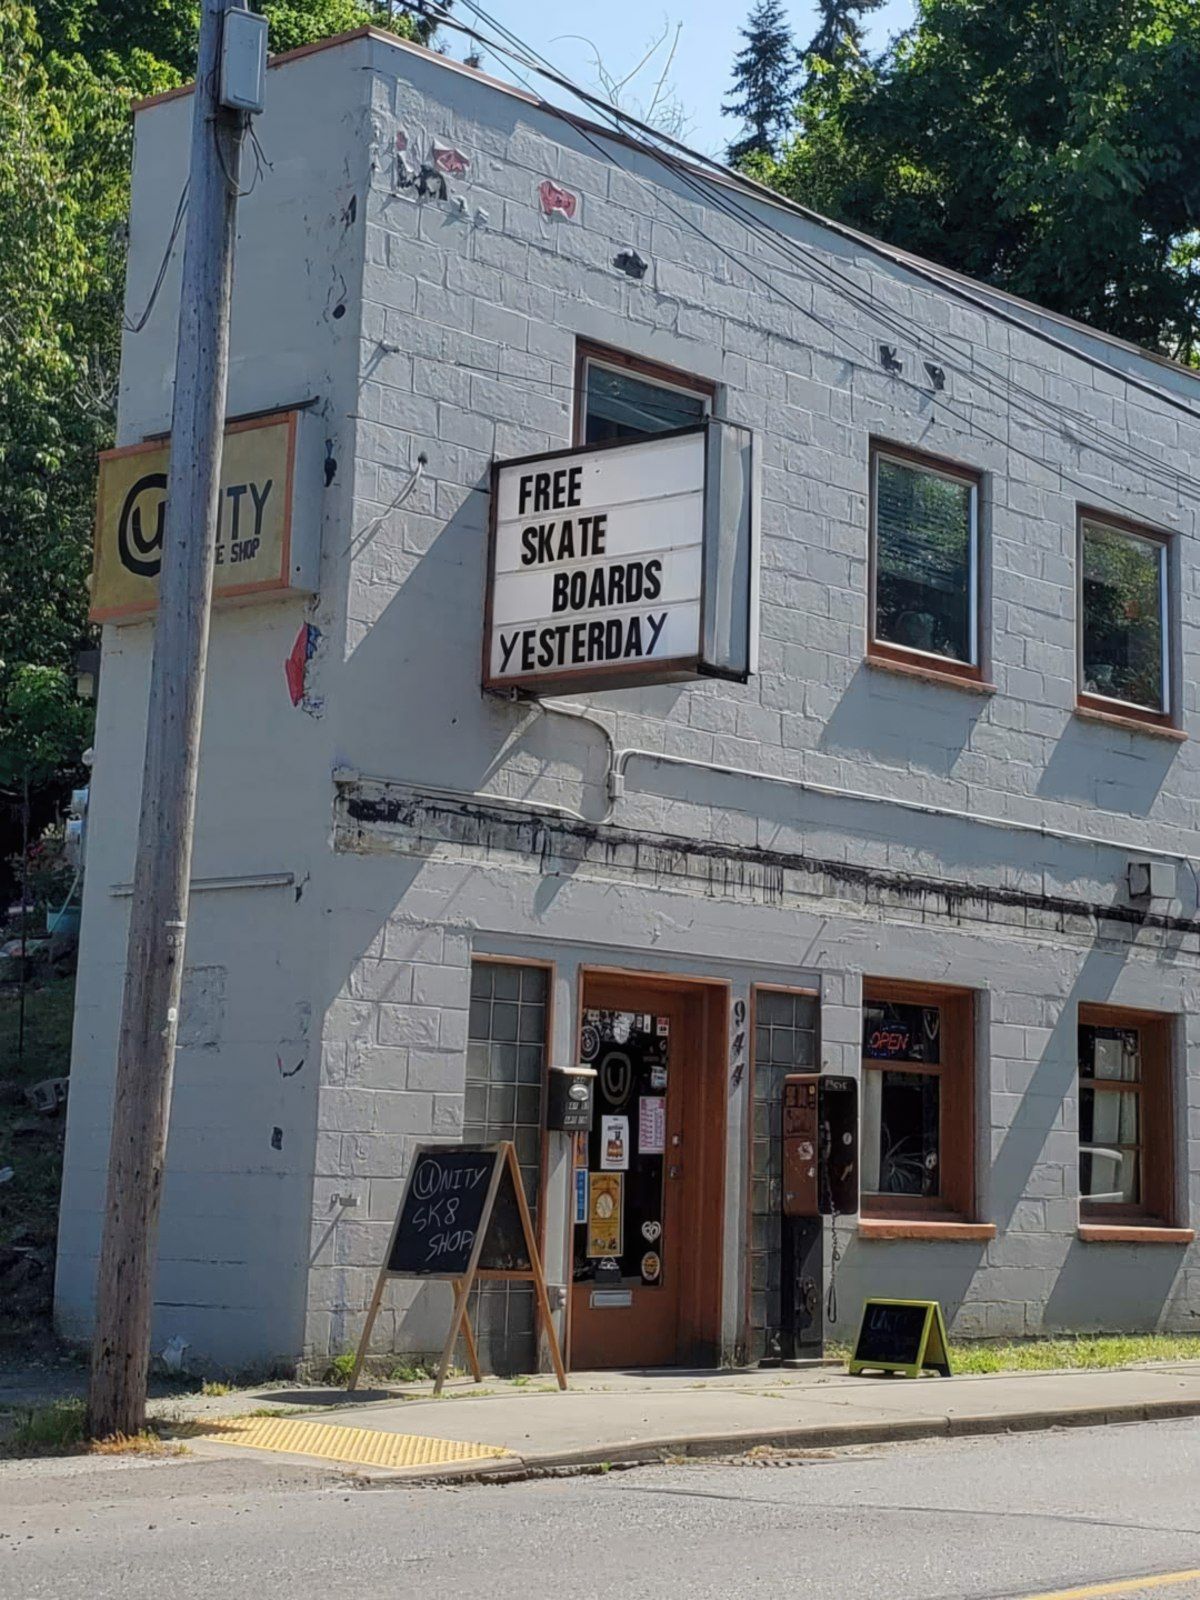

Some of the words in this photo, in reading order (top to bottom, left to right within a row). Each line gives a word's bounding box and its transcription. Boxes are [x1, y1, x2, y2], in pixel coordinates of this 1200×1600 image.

[519, 466, 583, 514] FREE
[230, 537, 260, 563] SHOP
[521, 514, 607, 565] SKATE
[552, 559, 662, 612] BOARDS
[499, 612, 668, 673] YESTERDAY
[731, 1000, 746, 1087] 944
[870, 1031, 909, 1050] OPEN
[414, 1161, 487, 1199] UNITY
[412, 1197, 460, 1232] SK8
